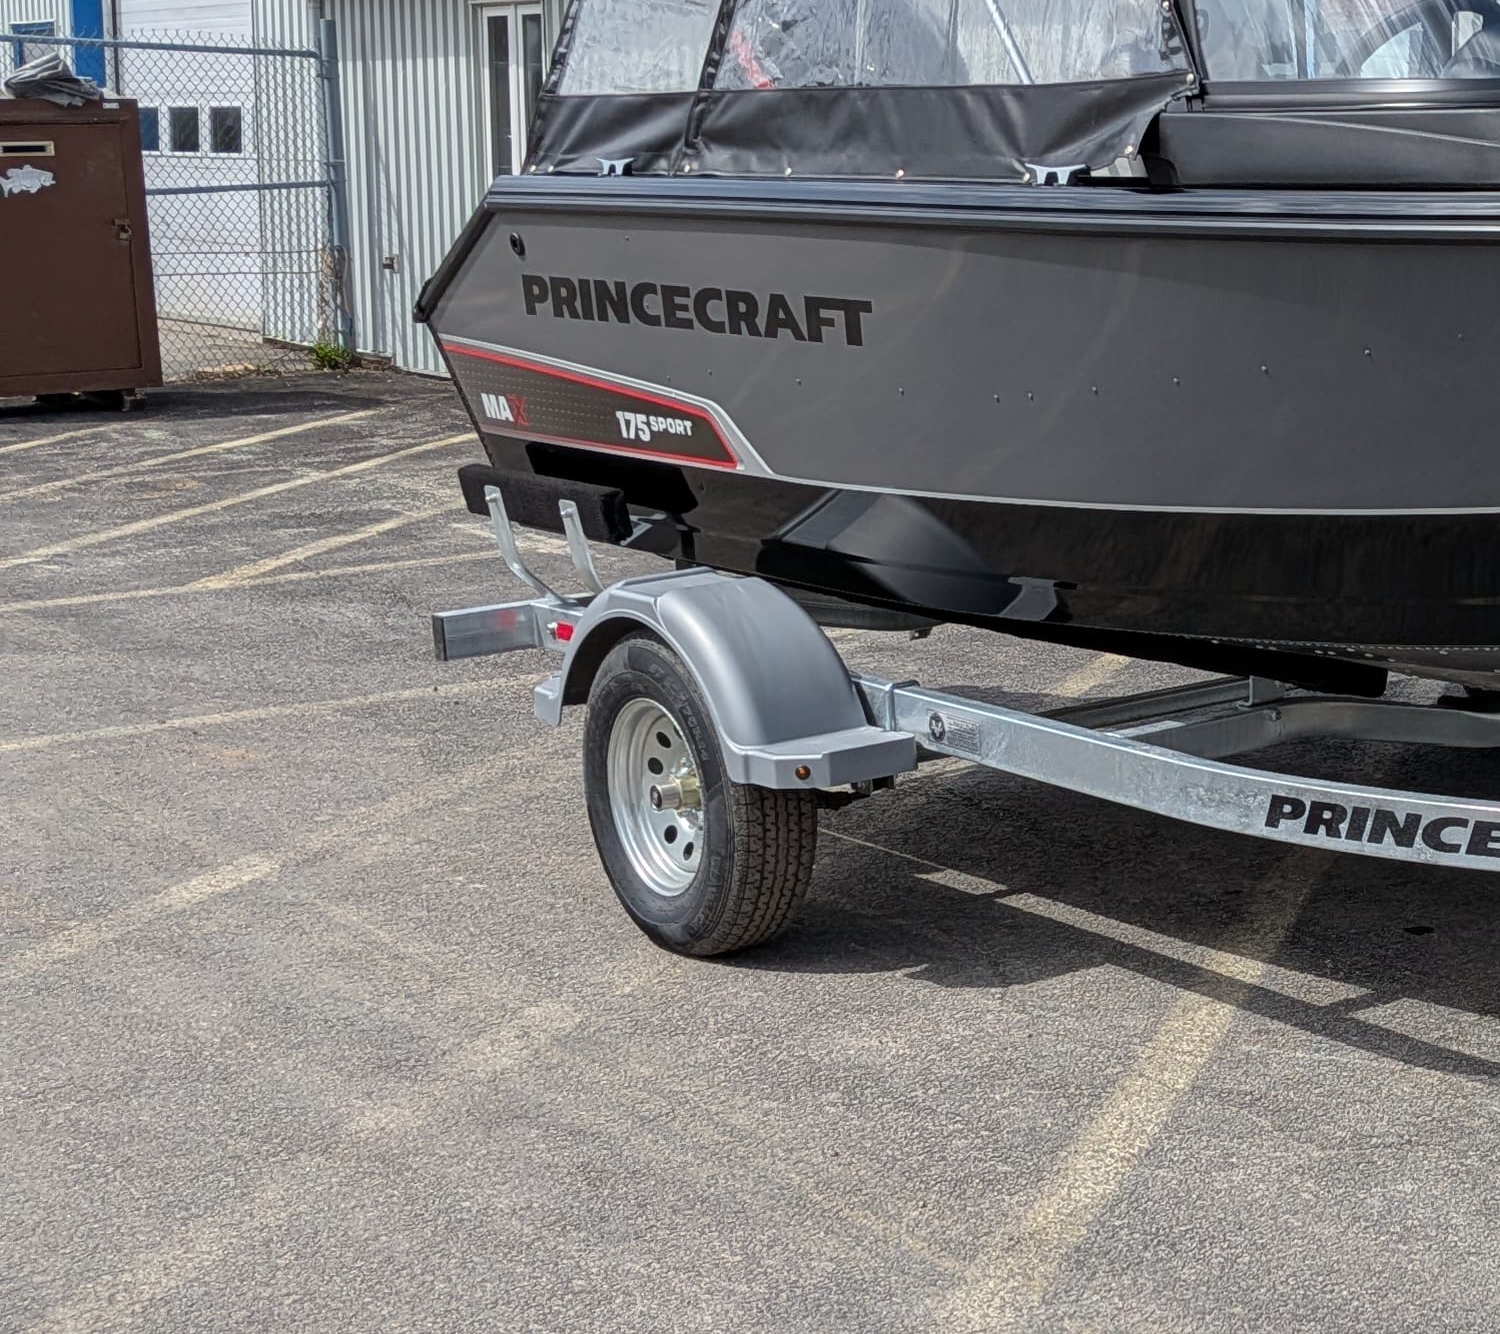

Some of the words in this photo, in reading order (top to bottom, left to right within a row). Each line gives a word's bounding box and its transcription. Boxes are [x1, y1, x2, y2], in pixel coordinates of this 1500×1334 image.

[521, 274, 873, 347] PRINCECRAFT
[480, 392, 531, 427] MAX
[615, 410, 651, 442] 175
[650, 416, 693, 437] SPORT
